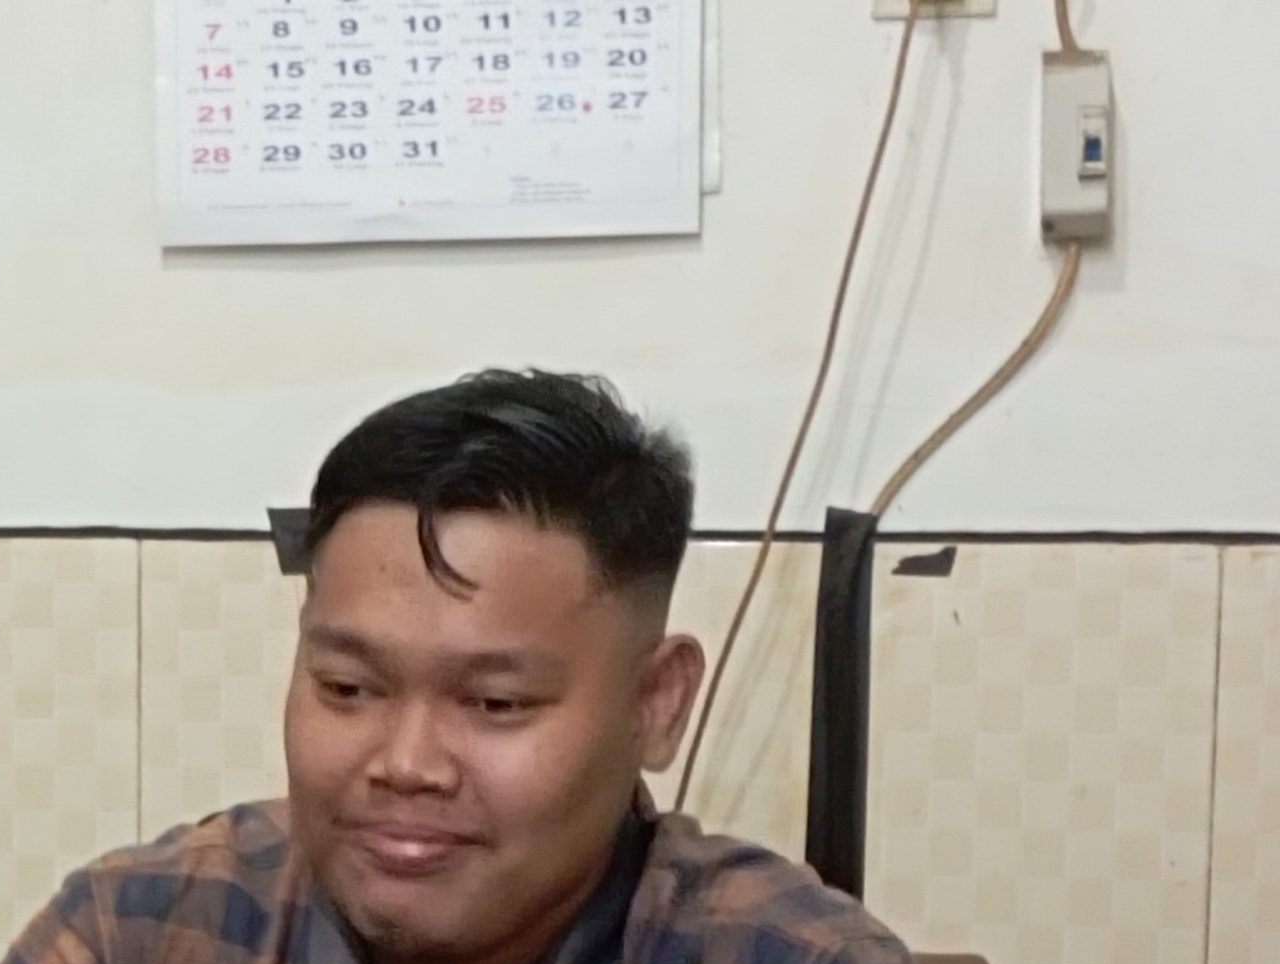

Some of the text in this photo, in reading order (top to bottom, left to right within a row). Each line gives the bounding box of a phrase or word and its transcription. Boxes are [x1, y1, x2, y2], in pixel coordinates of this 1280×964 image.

[204, 7, 652, 40] 7 8 9 10 11 12 13
[197, 49, 647, 80] 14 15 16 17 18 19 20
[197, 91, 648, 122] 21 22 23 24 25 26 27
[192, 141, 439, 165] 28 29 30 31
